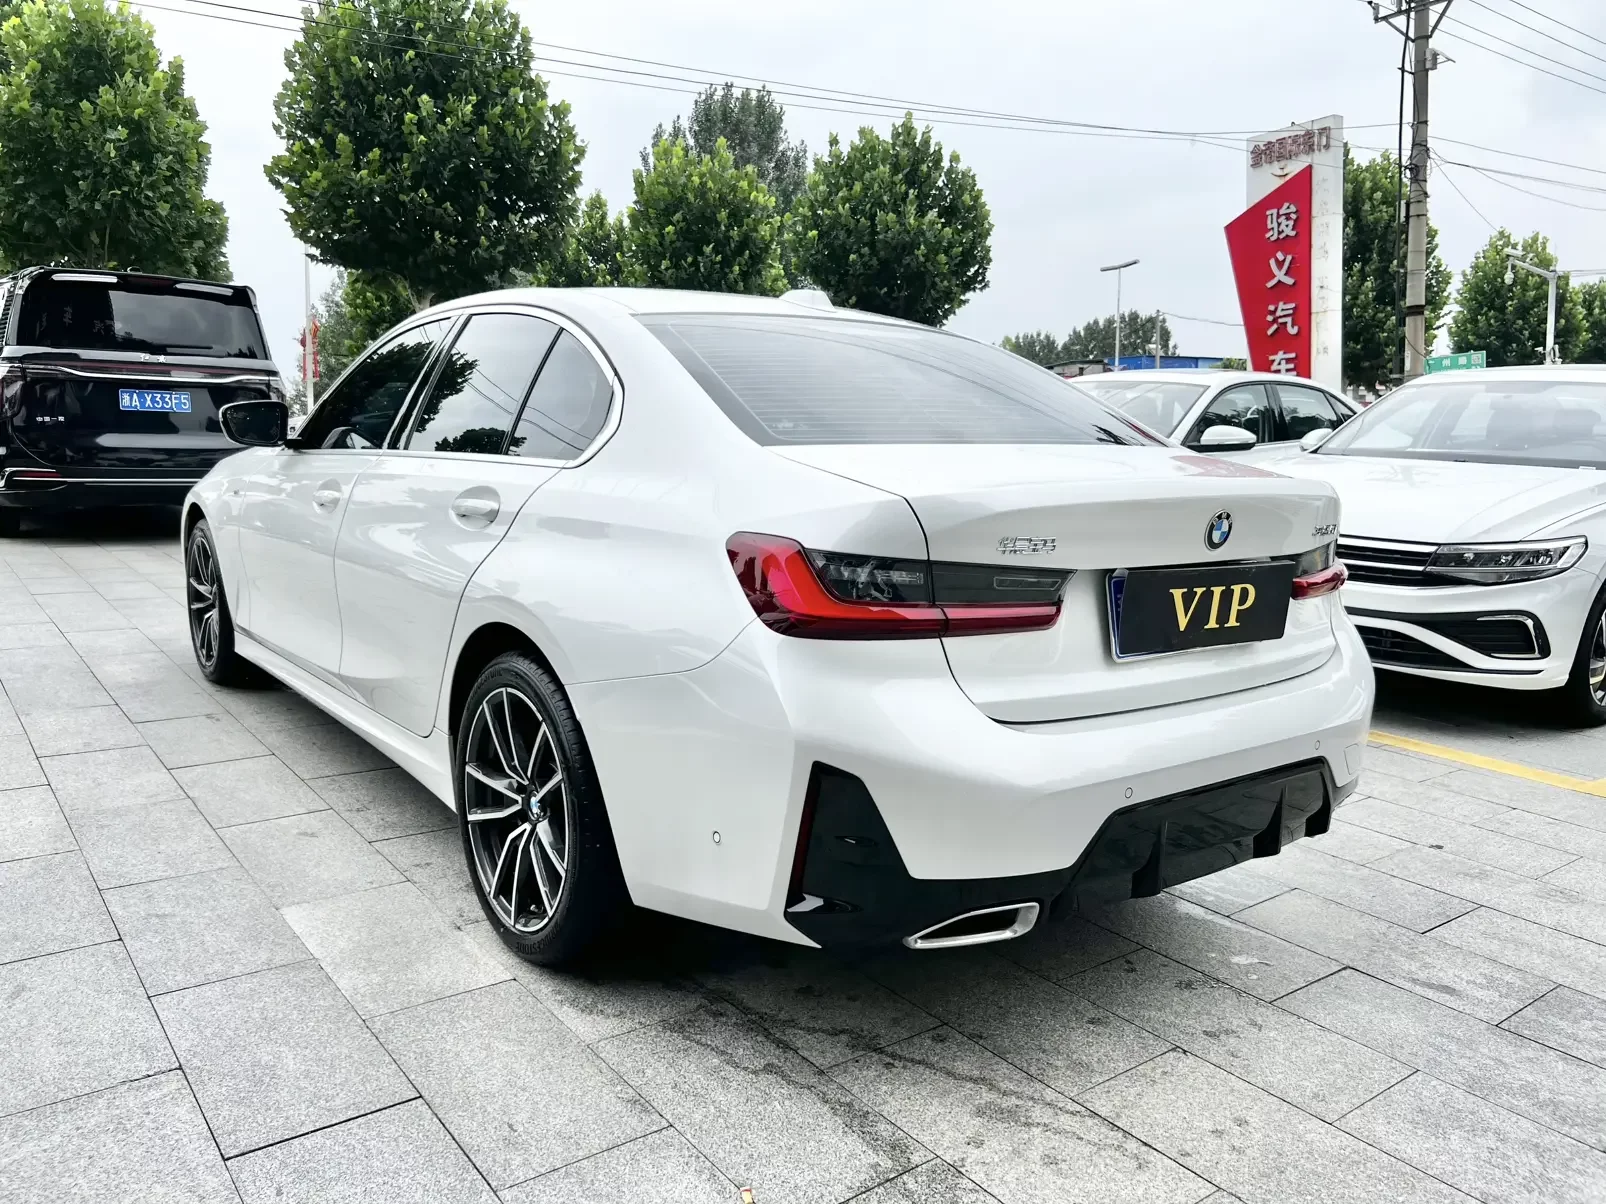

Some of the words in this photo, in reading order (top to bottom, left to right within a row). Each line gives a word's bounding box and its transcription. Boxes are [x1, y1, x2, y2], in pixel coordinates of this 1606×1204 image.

[1265, 202, 1299, 376] 骏义汽车
[1169, 583, 1256, 632] VIP
